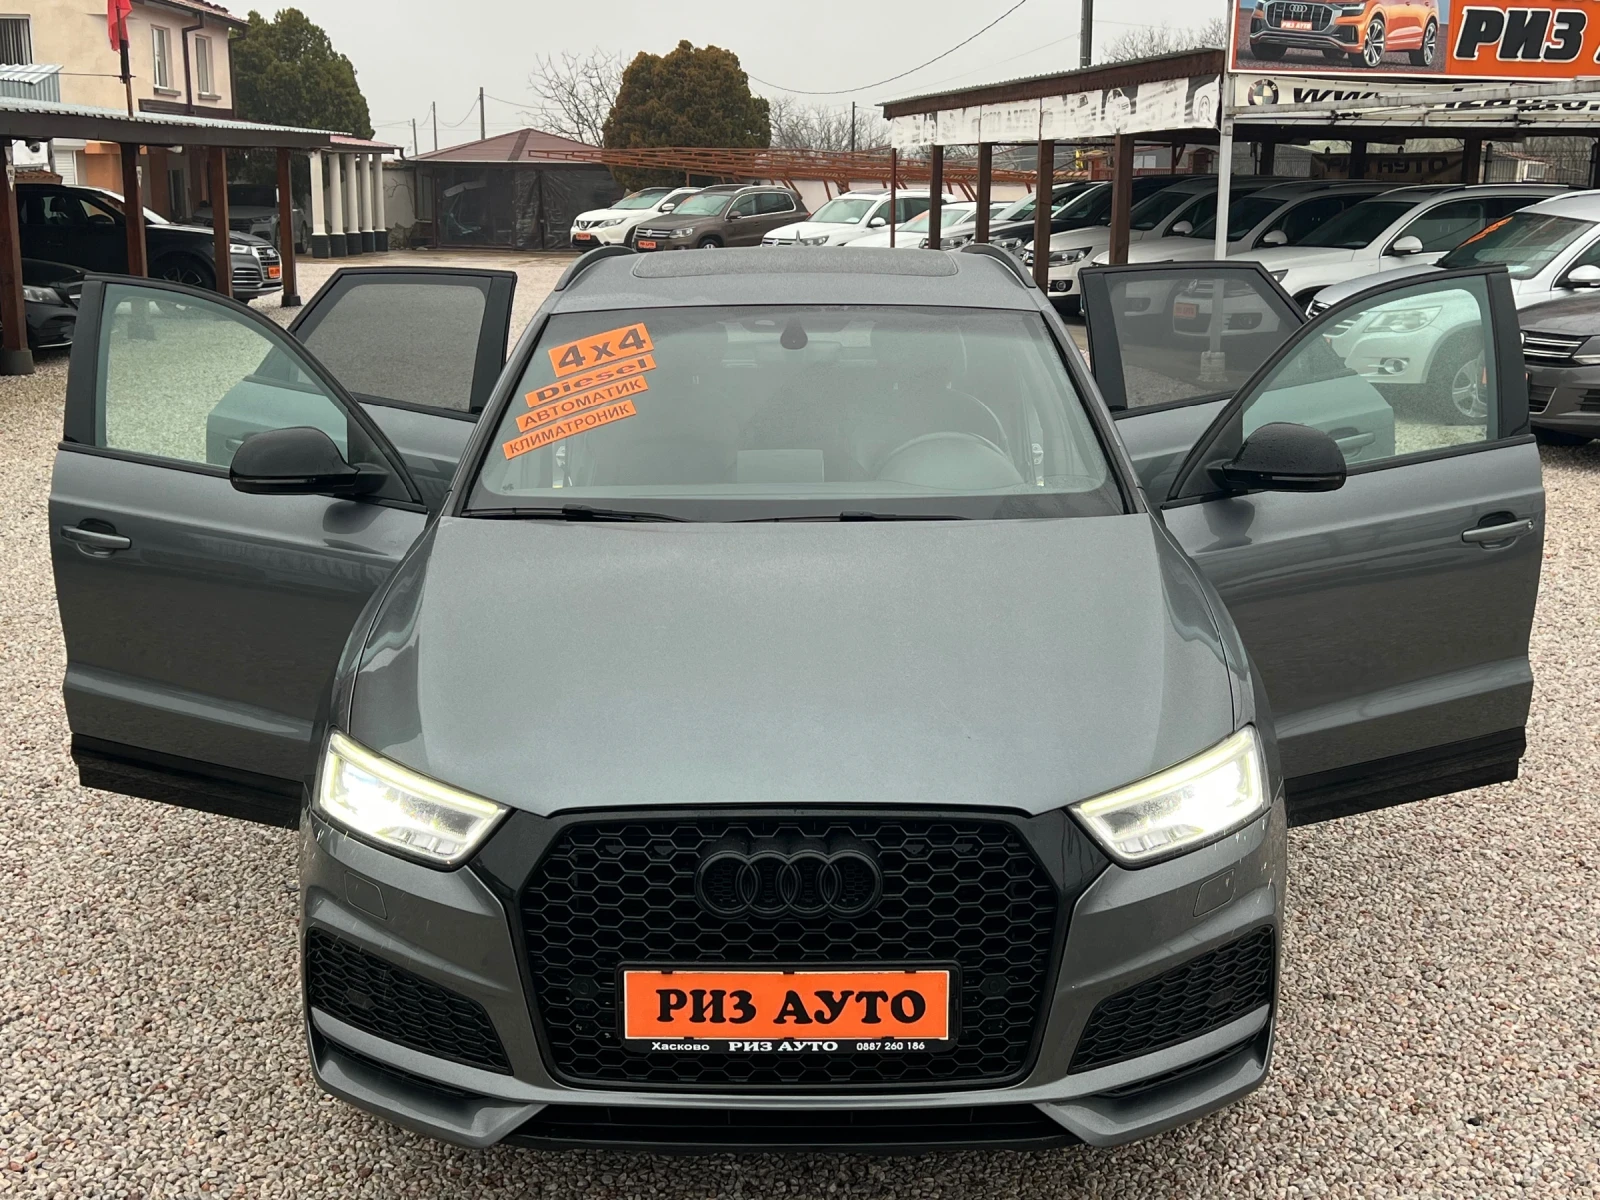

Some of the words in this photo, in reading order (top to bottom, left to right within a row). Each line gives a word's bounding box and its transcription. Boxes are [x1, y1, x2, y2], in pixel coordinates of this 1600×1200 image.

[1454, 6, 1588, 62] РИЗ
[558, 328, 646, 368] 4x4
[536, 358, 647, 402] Diesel
[524, 379, 642, 427] АВТОМАТИК
[509, 404, 630, 454] КЛИМАТРОНИК
[655, 989, 757, 1023] РИЗ
[773, 989, 926, 1024] АУТО
[651, 1041, 710, 1051] Хасково
[728, 1041, 773, 1052] РИЗ
[777, 1041, 839, 1052] АУТО
[856, 1041, 882, 1051] 0887
[884, 1041, 904, 1051] 260
[907, 1041, 926, 1051] 186
